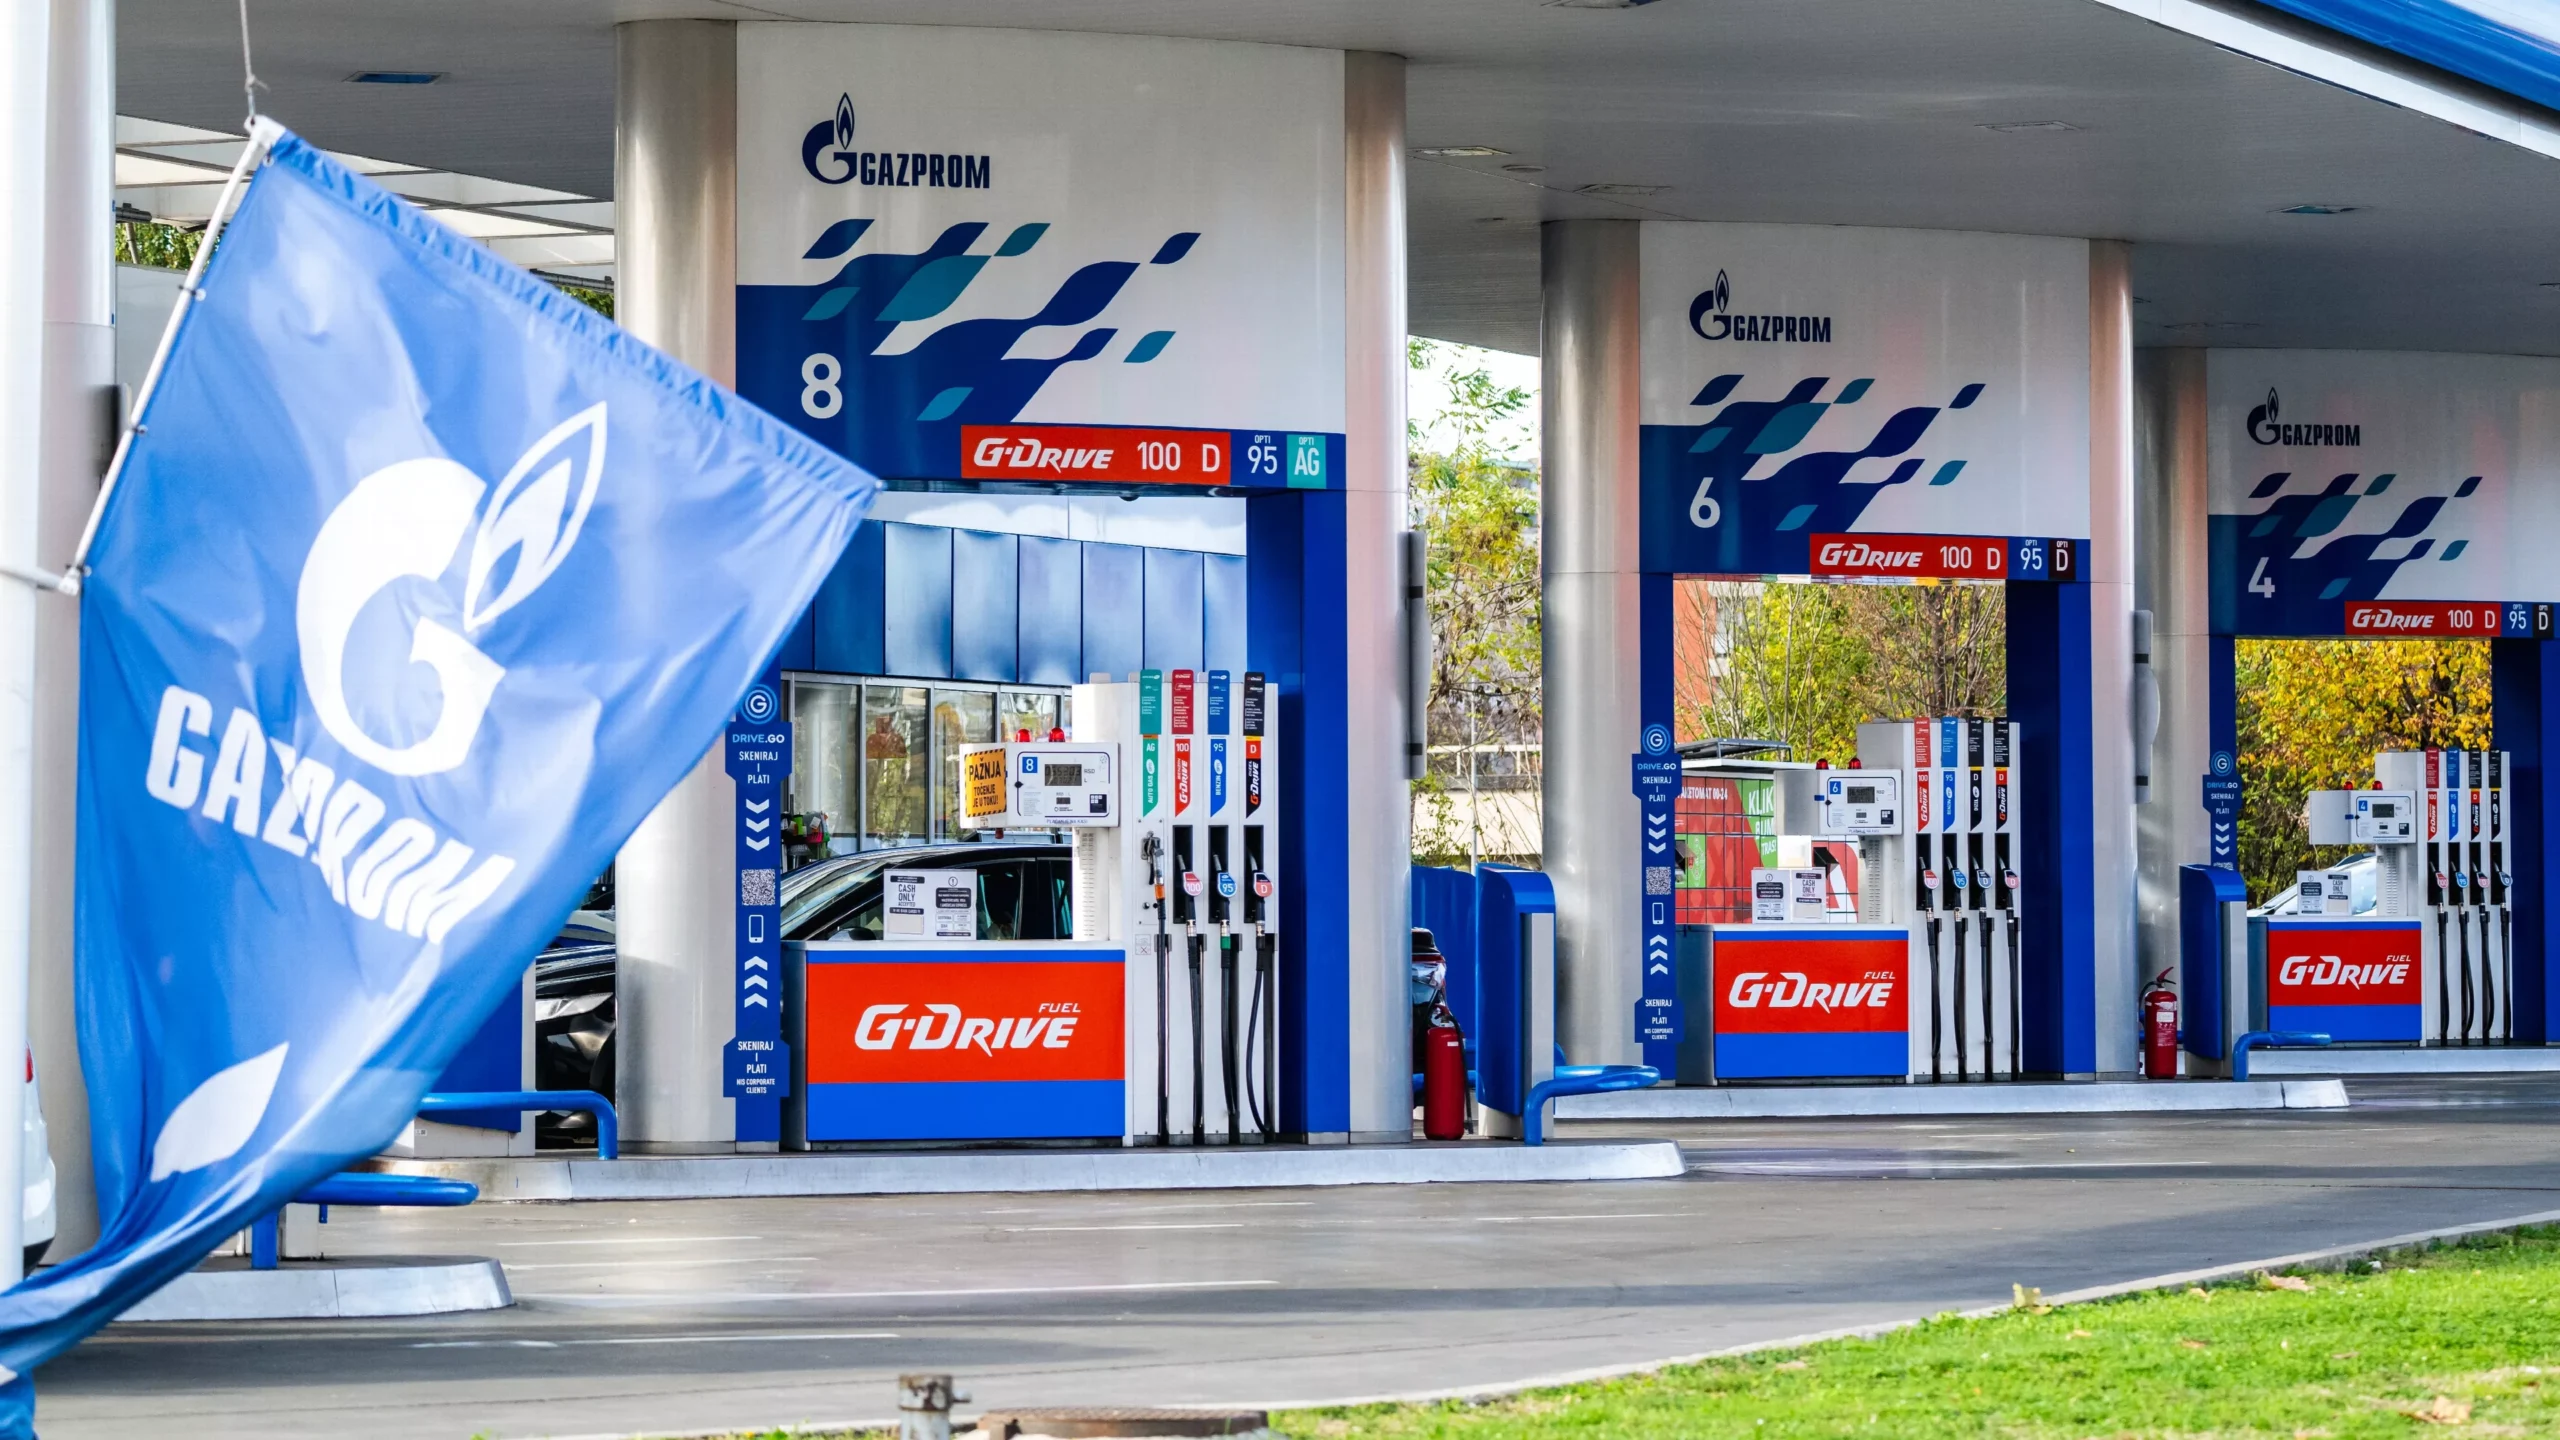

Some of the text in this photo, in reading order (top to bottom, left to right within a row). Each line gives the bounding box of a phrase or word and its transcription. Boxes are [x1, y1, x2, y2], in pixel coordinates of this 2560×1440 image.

[860, 152, 990, 189] GAZPROM
[1733, 315, 1831, 343] GAZPROM
[801, 353, 842, 419] 8
[1254, 435, 1271, 444] OPTI
[2282, 424, 2360, 446] GAZPROM
[1298, 436, 1315, 446] OPTI
[1136, 441, 1181, 471] 100
[1202, 444, 1221, 472] D
[1248, 445, 1278, 475] 95
[1294, 447, 1320, 477] AG
[1689, 477, 1720, 528] 6
[2025, 539, 2038, 547] OPTI
[2056, 540, 2069, 548] OPTI
[1940, 546, 1972, 569] 100
[1987, 548, 2000, 571] D
[2020, 548, 2043, 570] 95
[2056, 549, 2069, 572] D
[2248, 557, 2275, 598] 4
[2447, 609, 2474, 628] 100
[2485, 610, 2496, 629] D
[2509, 611, 2527, 630] 95
[2538, 612, 2549, 630] D
[732, 734, 785, 743] DRIVE.GO
[1146, 743, 1155, 752] AG
[1176, 743, 1189, 752] 100
[1213, 743, 1223, 752] 95
[1250, 744, 1257, 754] D
[739, 751, 778, 761] SKENIRAJ
[969, 757, 1001, 781] PAŽNJA
[1026, 758, 1034, 772] 8
[747, 774, 770, 784] PLATI
[1642, 776, 1672, 784] SKENIRAJ
[974, 783, 996, 796] TOČENJE
[1832, 783, 1838, 793] 6
[1648, 794, 1666, 802] PLATI
[1678, 787, 1712, 800] AKETOMAT
[1748, 786, 1774, 818] KLIK
[2360, 801, 2366, 810] 4
[1802, 879, 1816, 887] CASH
[2010, 878, 2016, 886] D
[898, 884, 916, 893] CASH
[1186, 883, 1201, 893] 100
[1222, 883, 1233, 893] 95
[1261, 884, 1268, 894] D
[898, 893, 915, 901] ONLY
[1864, 971, 1896, 980] FUEL
[1038, 1002, 1081, 1013] FUEL
[1645, 999, 1672, 1007] SKENIRAJ
[738, 1041, 774, 1051] SKENIRAJ
[746, 1064, 767, 1074] PLATI
[746, 1086, 767, 1094] CLIENTS
